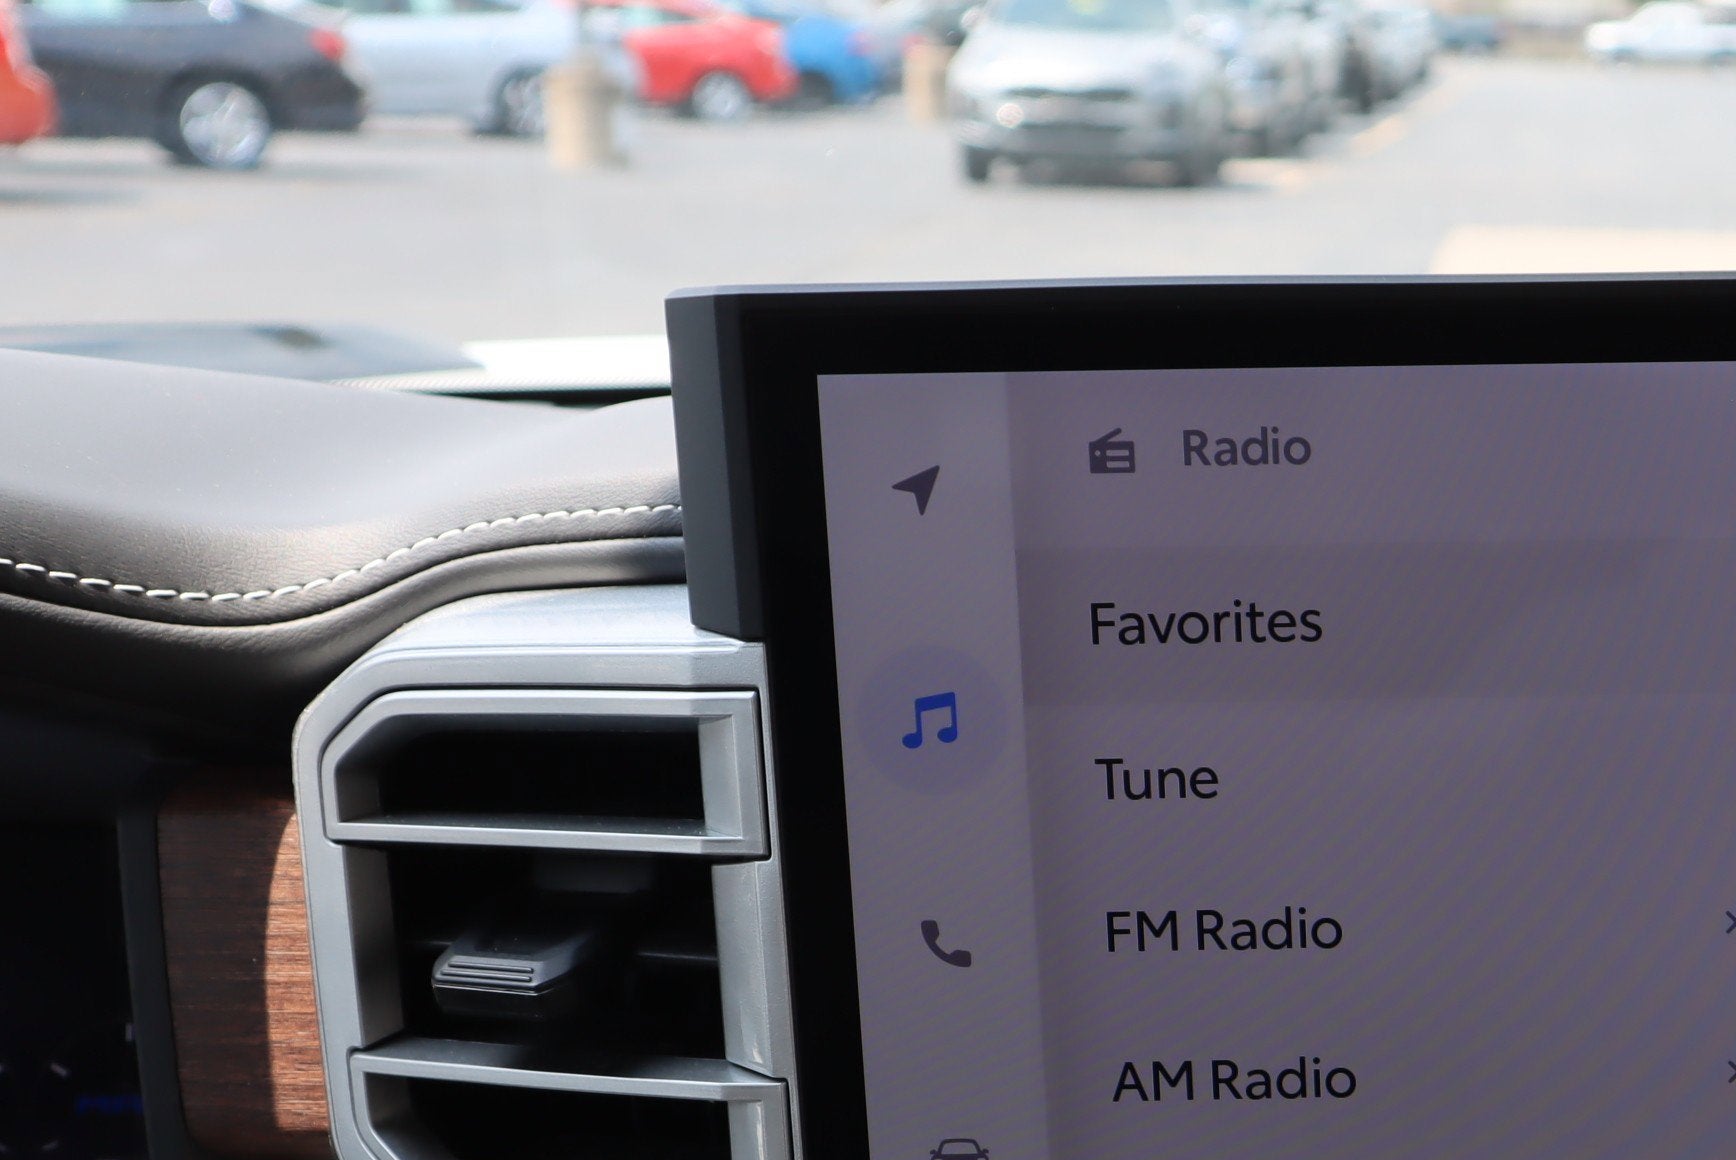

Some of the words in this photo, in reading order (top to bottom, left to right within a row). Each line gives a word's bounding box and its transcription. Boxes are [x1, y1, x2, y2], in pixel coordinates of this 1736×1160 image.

[1182, 425, 1312, 467] Radio
[1090, 599, 1323, 646] Favorites
[1094, 757, 1219, 801] Tune
[1106, 910, 1179, 953] FM
[1196, 905, 1343, 951] Radio
[1112, 1060, 1194, 1103] AM
[1211, 1055, 1357, 1101] Radio
